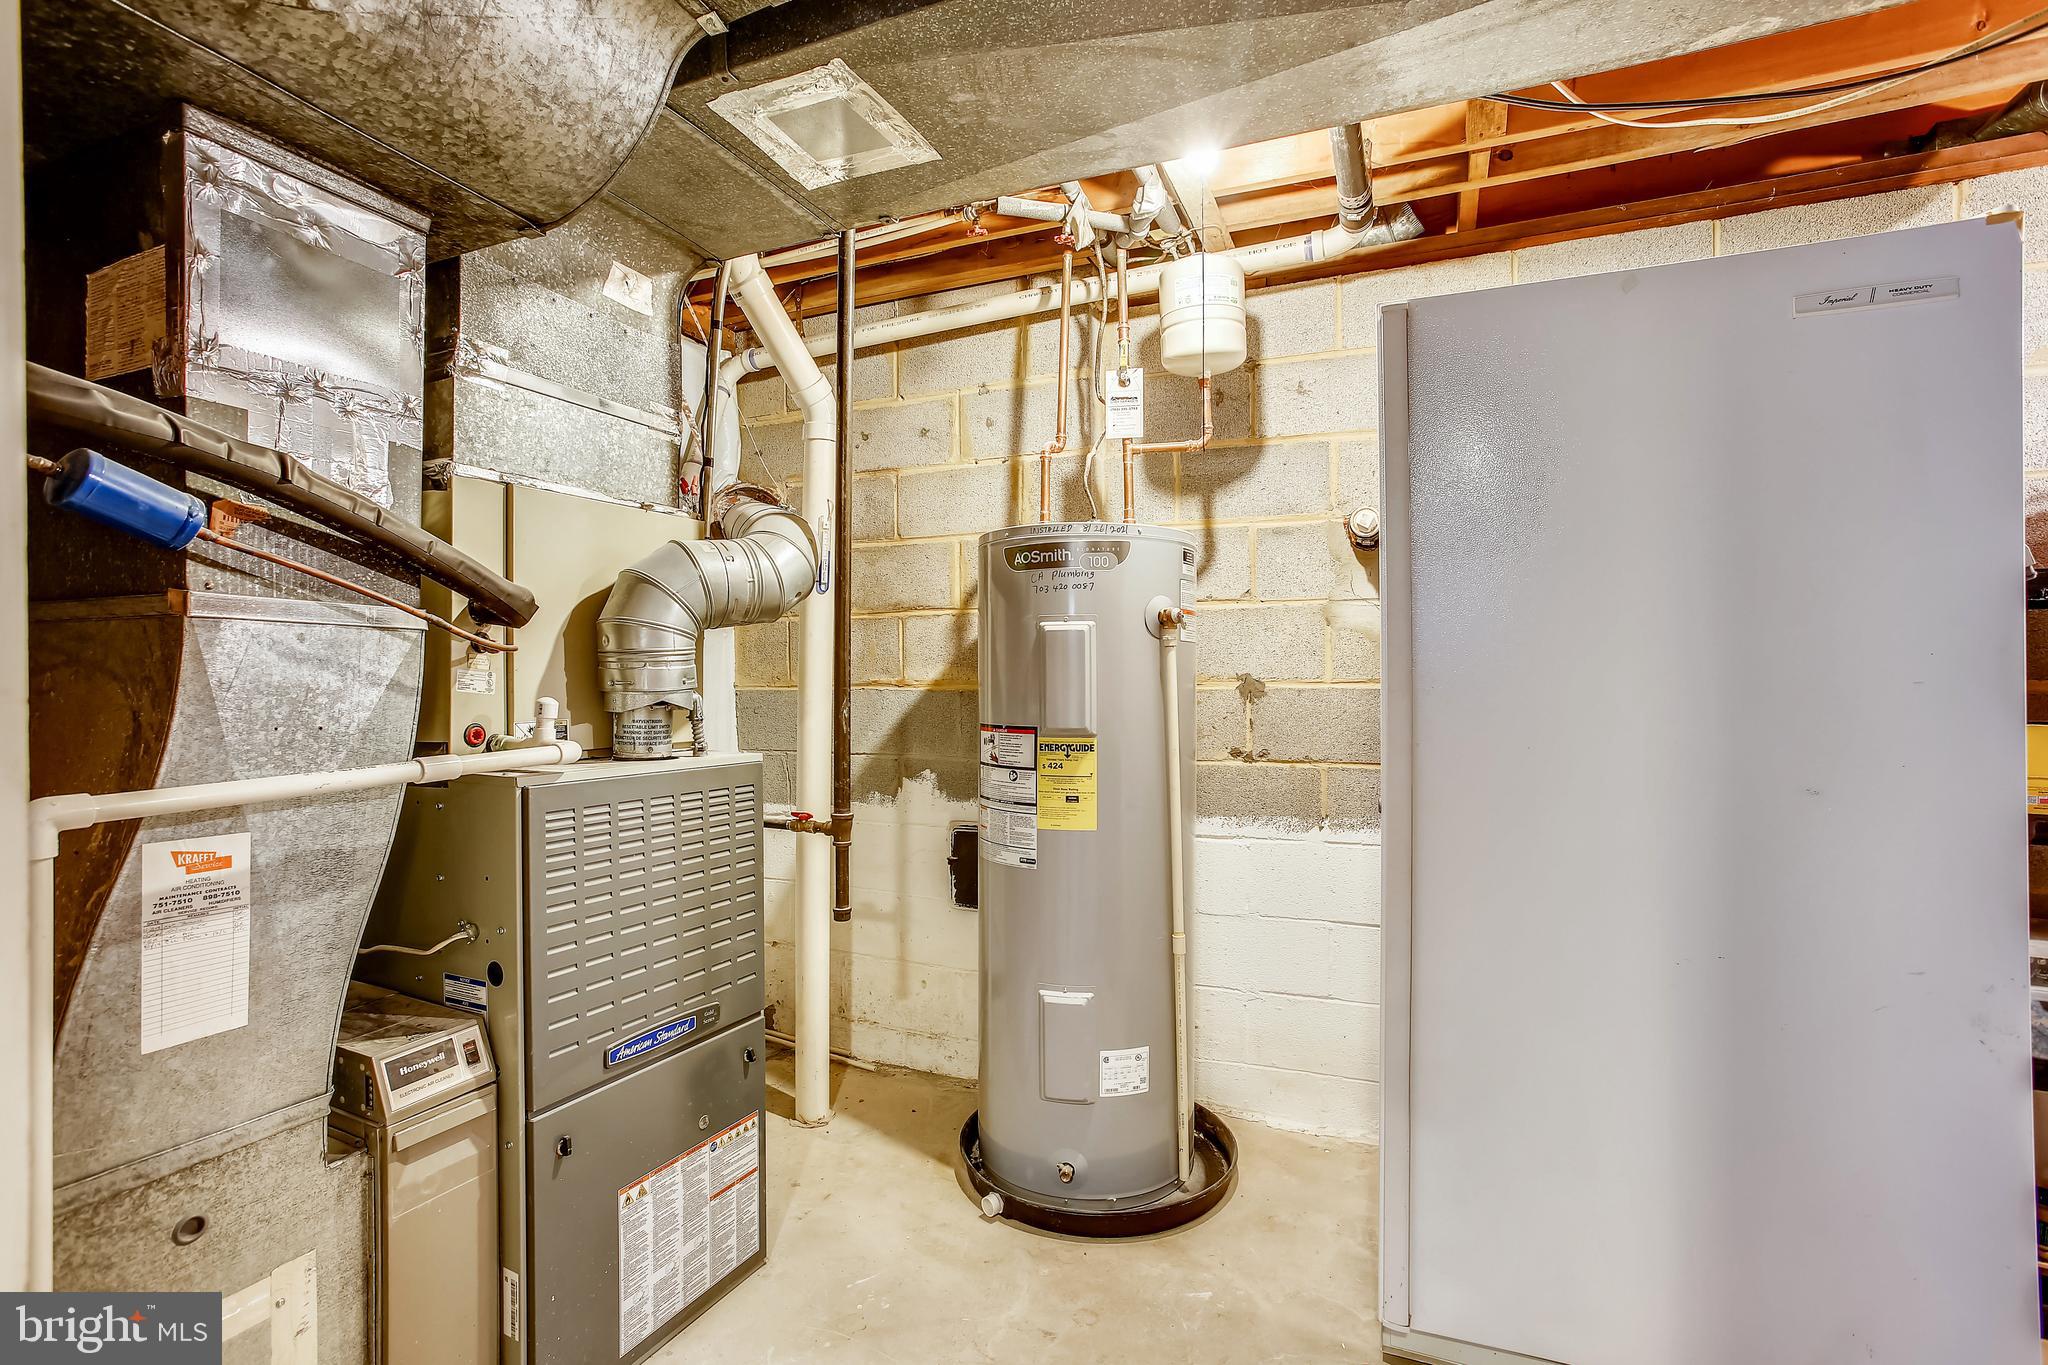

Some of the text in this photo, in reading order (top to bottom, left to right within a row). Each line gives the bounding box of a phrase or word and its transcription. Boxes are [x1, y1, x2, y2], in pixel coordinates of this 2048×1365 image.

[1275, 242, 1297, 250] FOR
[1819, 292, 1858, 306] Imperial
[881, 317, 922, 328] PRESSURE
[1030, 525, 1073, 535] INSTALLED
[1014, 548, 1072, 566] AOSmith
[1088, 556, 1109, 568] 100
[1032, 581, 1095, 594] 703 420 0087
[178, 853, 214, 865] KRAFFT
[183, 880, 224, 890] CONDITIONING
[185, 876, 211, 884] HEATING
[152, 889, 240, 909] 751-7510 898-7510
[159, 885, 236, 901] MAINTENANCE CONTRACTS
[163, 904, 193, 914] CLEANERS
[616, 1019, 691, 1061] American Standard
[399, 1052, 445, 1075] Honeywell
[399, 1084, 427, 1098] ELECTRONIC
[435, 1073, 454, 1083] CLEANER
